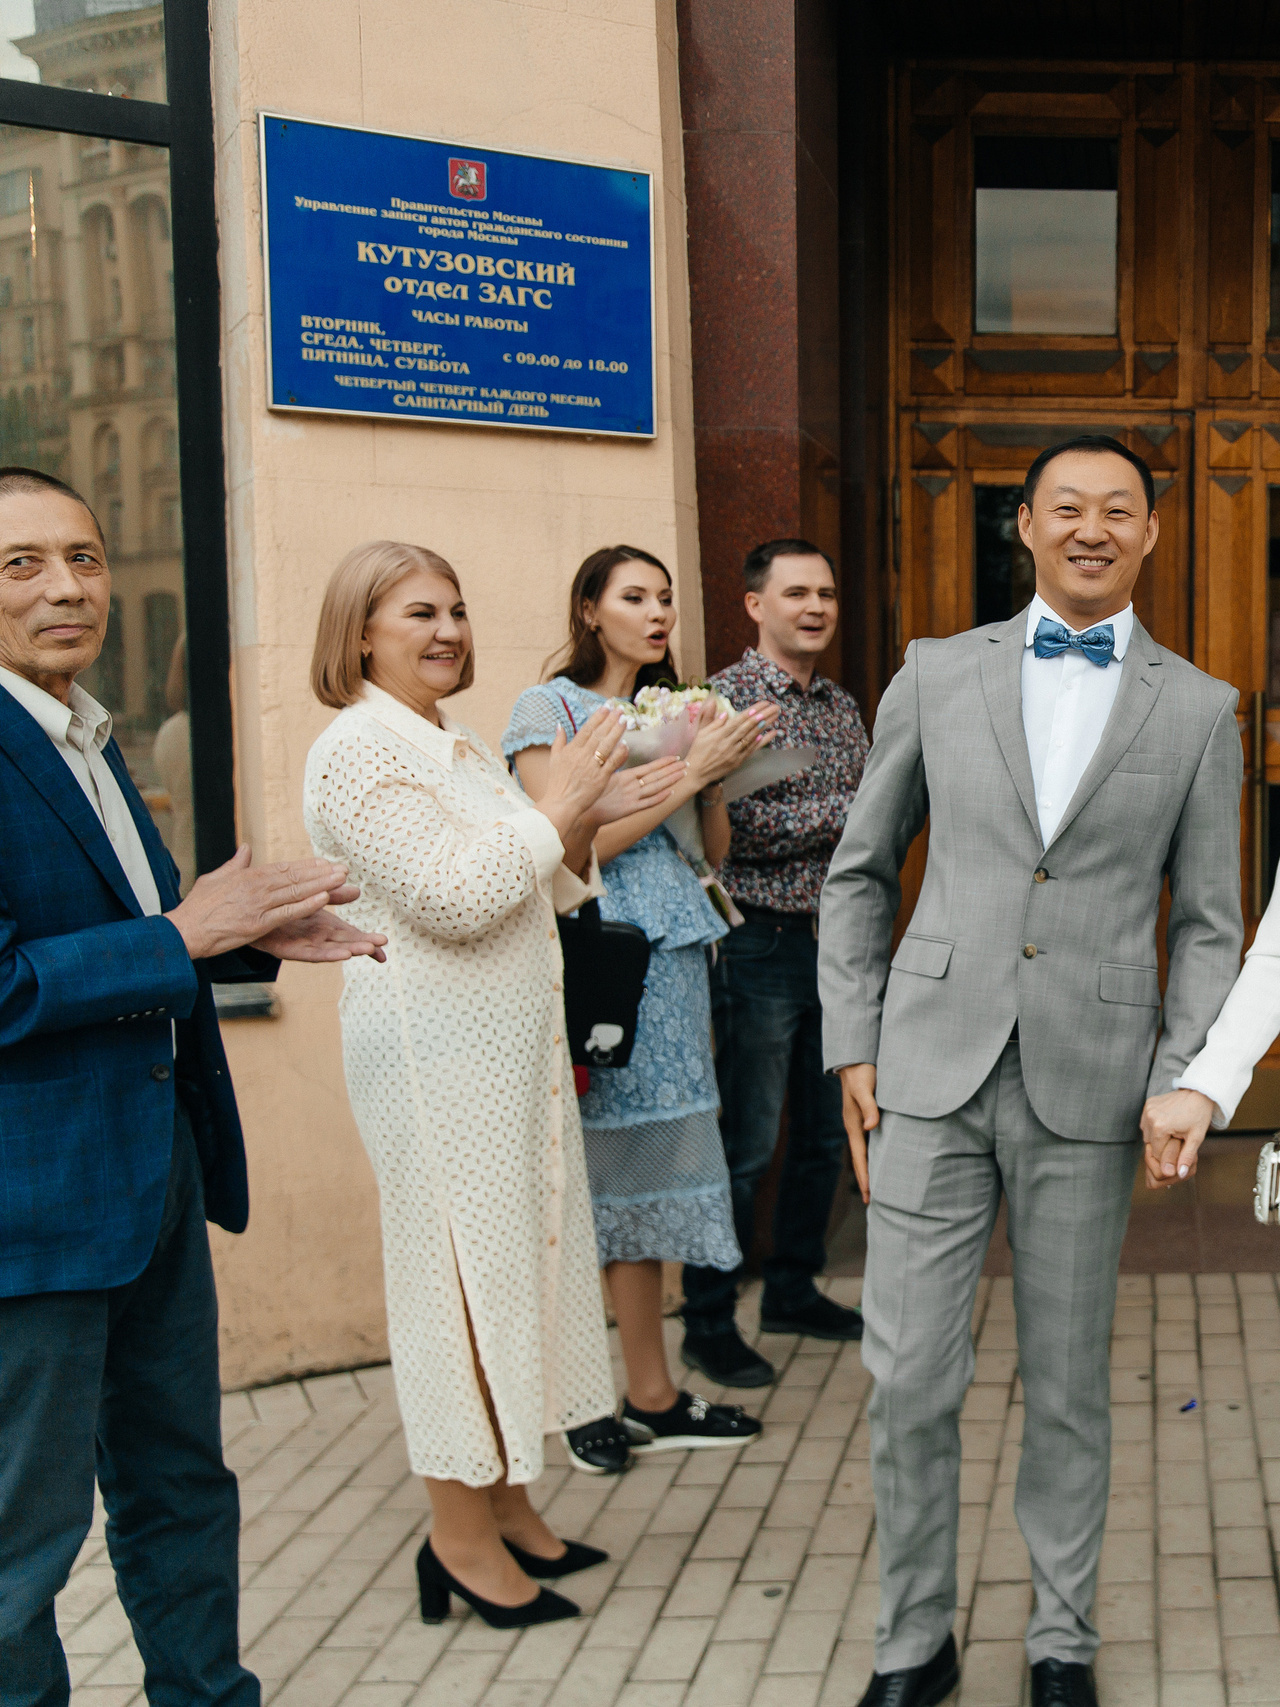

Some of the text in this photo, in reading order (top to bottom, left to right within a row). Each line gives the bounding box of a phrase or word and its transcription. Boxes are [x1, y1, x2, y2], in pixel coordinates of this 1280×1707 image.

[294, 195, 629, 249] Управление записи актов гражданского состояния
[391, 196, 543, 227] Правительство Москвы
[418, 225, 519, 246] города Москвы
[357, 240, 576, 286] КУТУЗОВСКИЙ
[384, 276, 553, 310] отдел ЗАГС
[301, 315, 386, 336] ВТОРНИК,
[411, 309, 528, 333] ЧАСЫ РАБОТЫ
[394, 356, 471, 375] СУББОТА
[502, 352, 629, 374] с 09.00 до 18.00
[334, 374, 602, 407] ЧЕТВЕРТЫЙ ЧЕТВЕРГ КАЖДОГО МЕСЯЦА
[393, 393, 550, 418] САНИТАРНЫЙ ДЕНЬ
